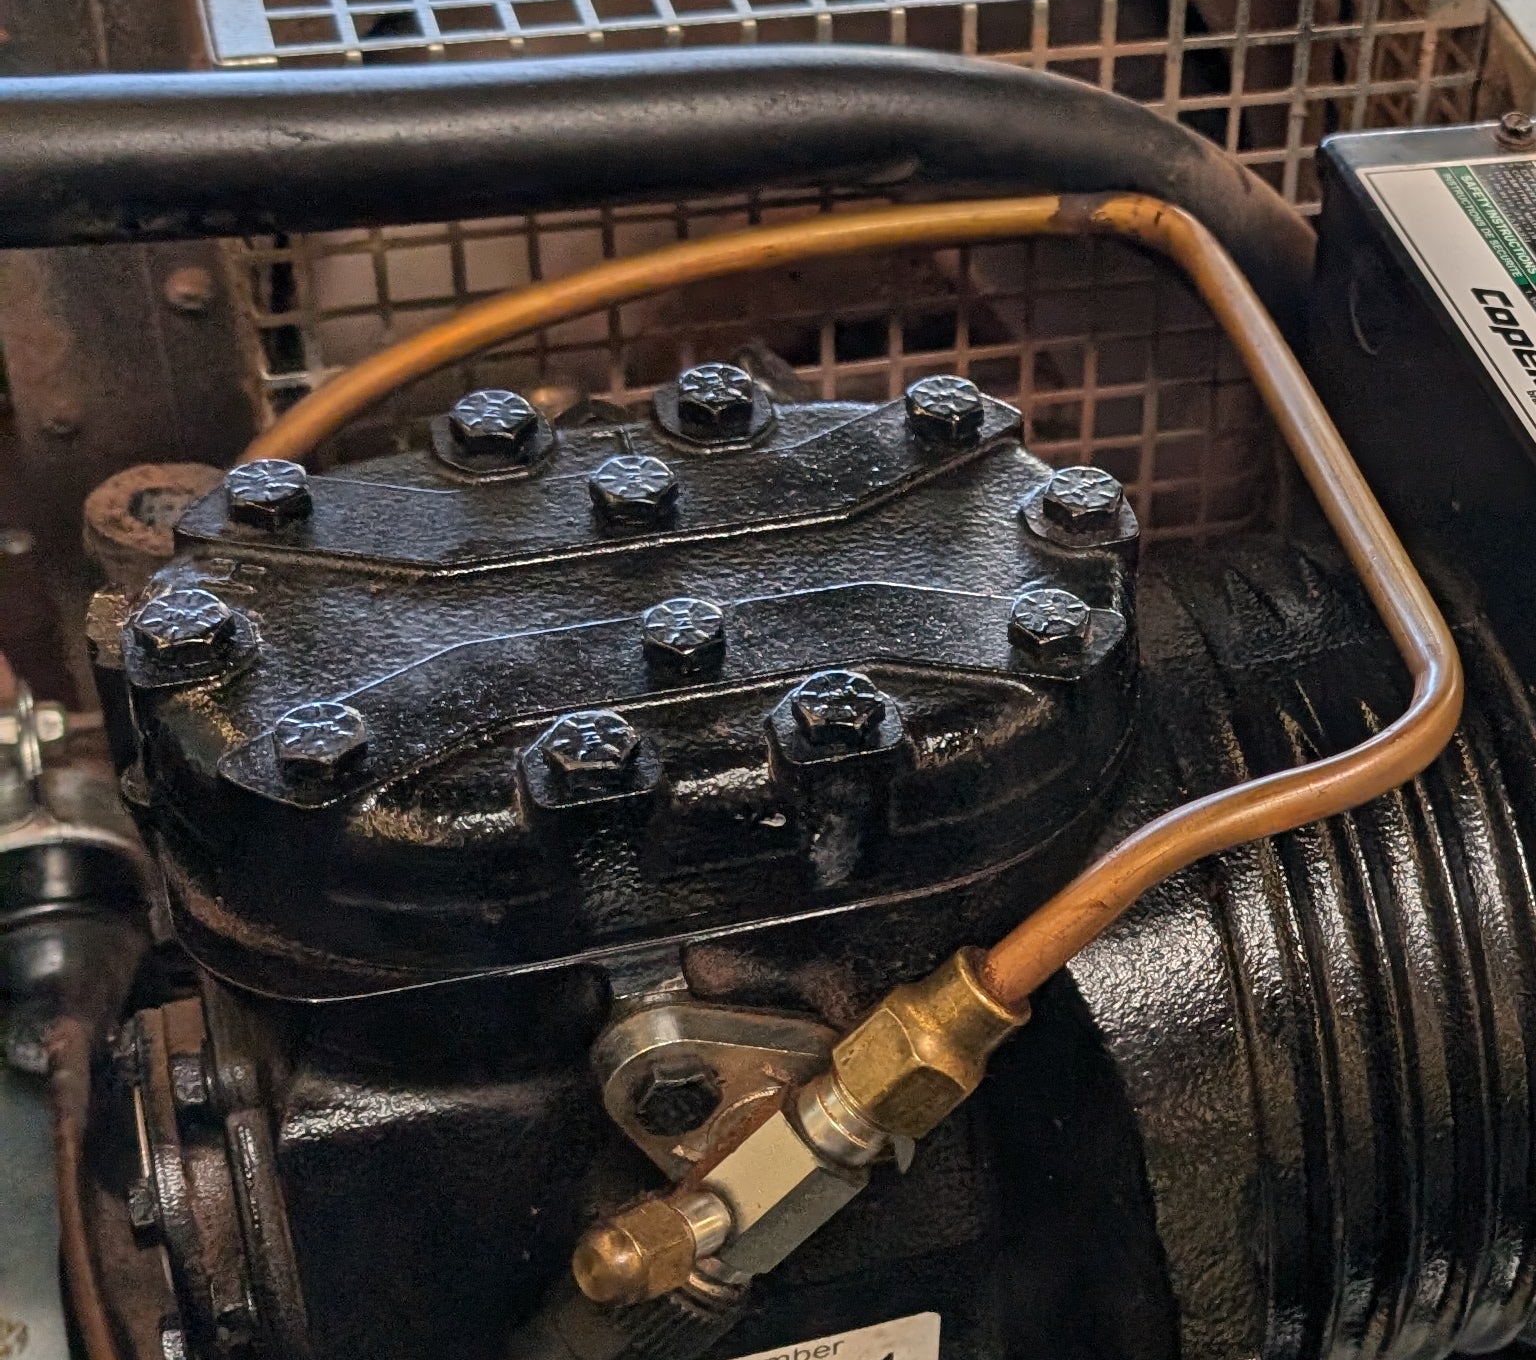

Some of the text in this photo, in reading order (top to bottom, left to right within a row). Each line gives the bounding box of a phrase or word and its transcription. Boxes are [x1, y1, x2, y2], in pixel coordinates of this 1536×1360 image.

[1440, 173, 1487, 226] INSTRUCTIONS
[1459, 175, 1493, 209] SAFETY
[1479, 228, 1496, 238] DE
[1487, 239, 1523, 277] SECURITE
